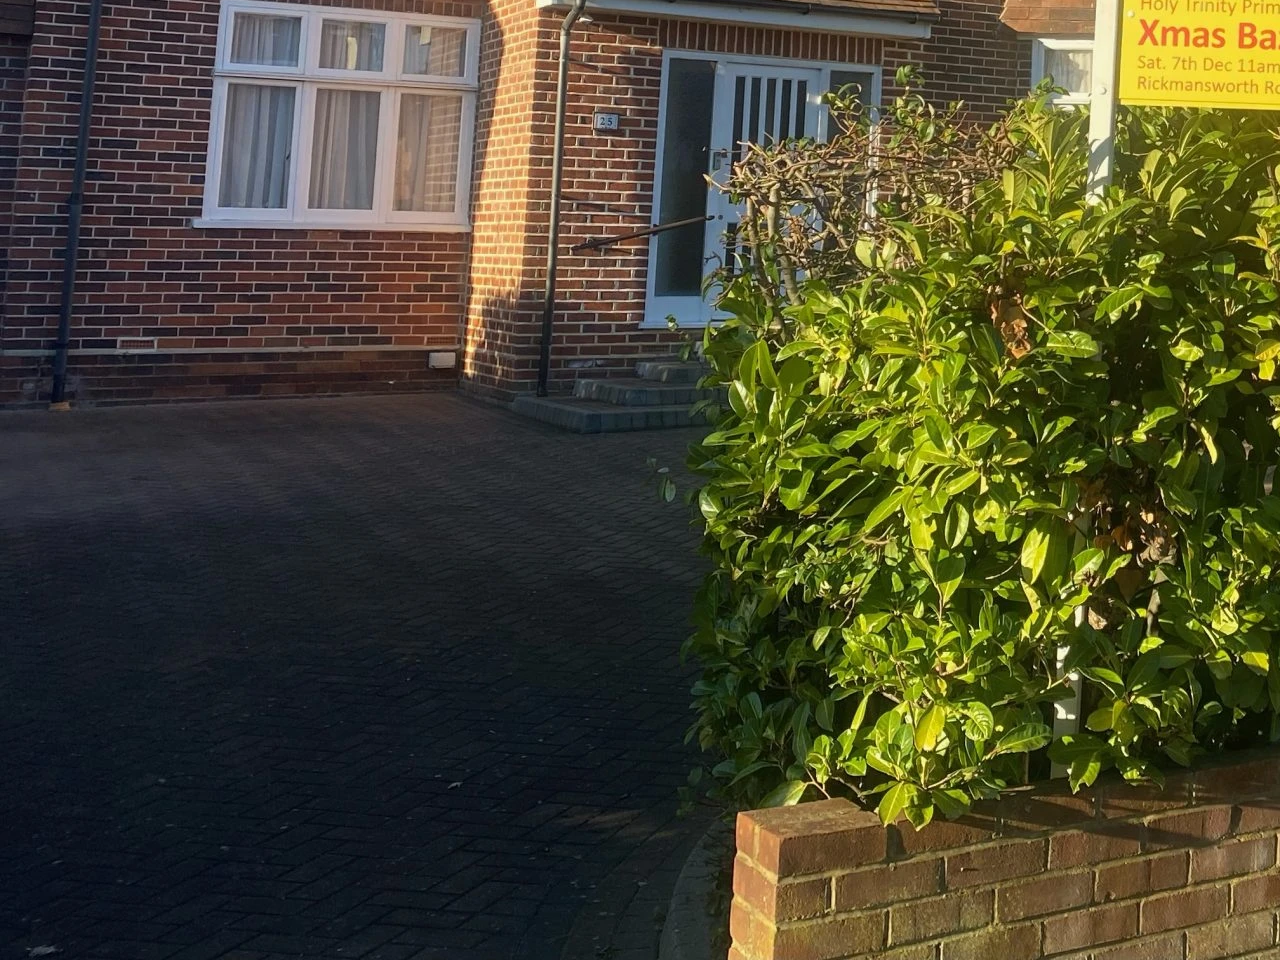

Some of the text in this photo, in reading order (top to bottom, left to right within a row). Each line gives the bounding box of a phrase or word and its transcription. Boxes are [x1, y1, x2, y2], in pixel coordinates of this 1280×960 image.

[1137, 19, 1226, 49] Xmas
[1137, 55, 1166, 70] Sat.
[1172, 56, 1197, 71] 7th
[1203, 58, 1232, 72] Dec
[1237, 59, 1280, 74] 11am
[1137, 76, 1259, 94] Rickmansworth
[600, 116, 613, 126] 25
